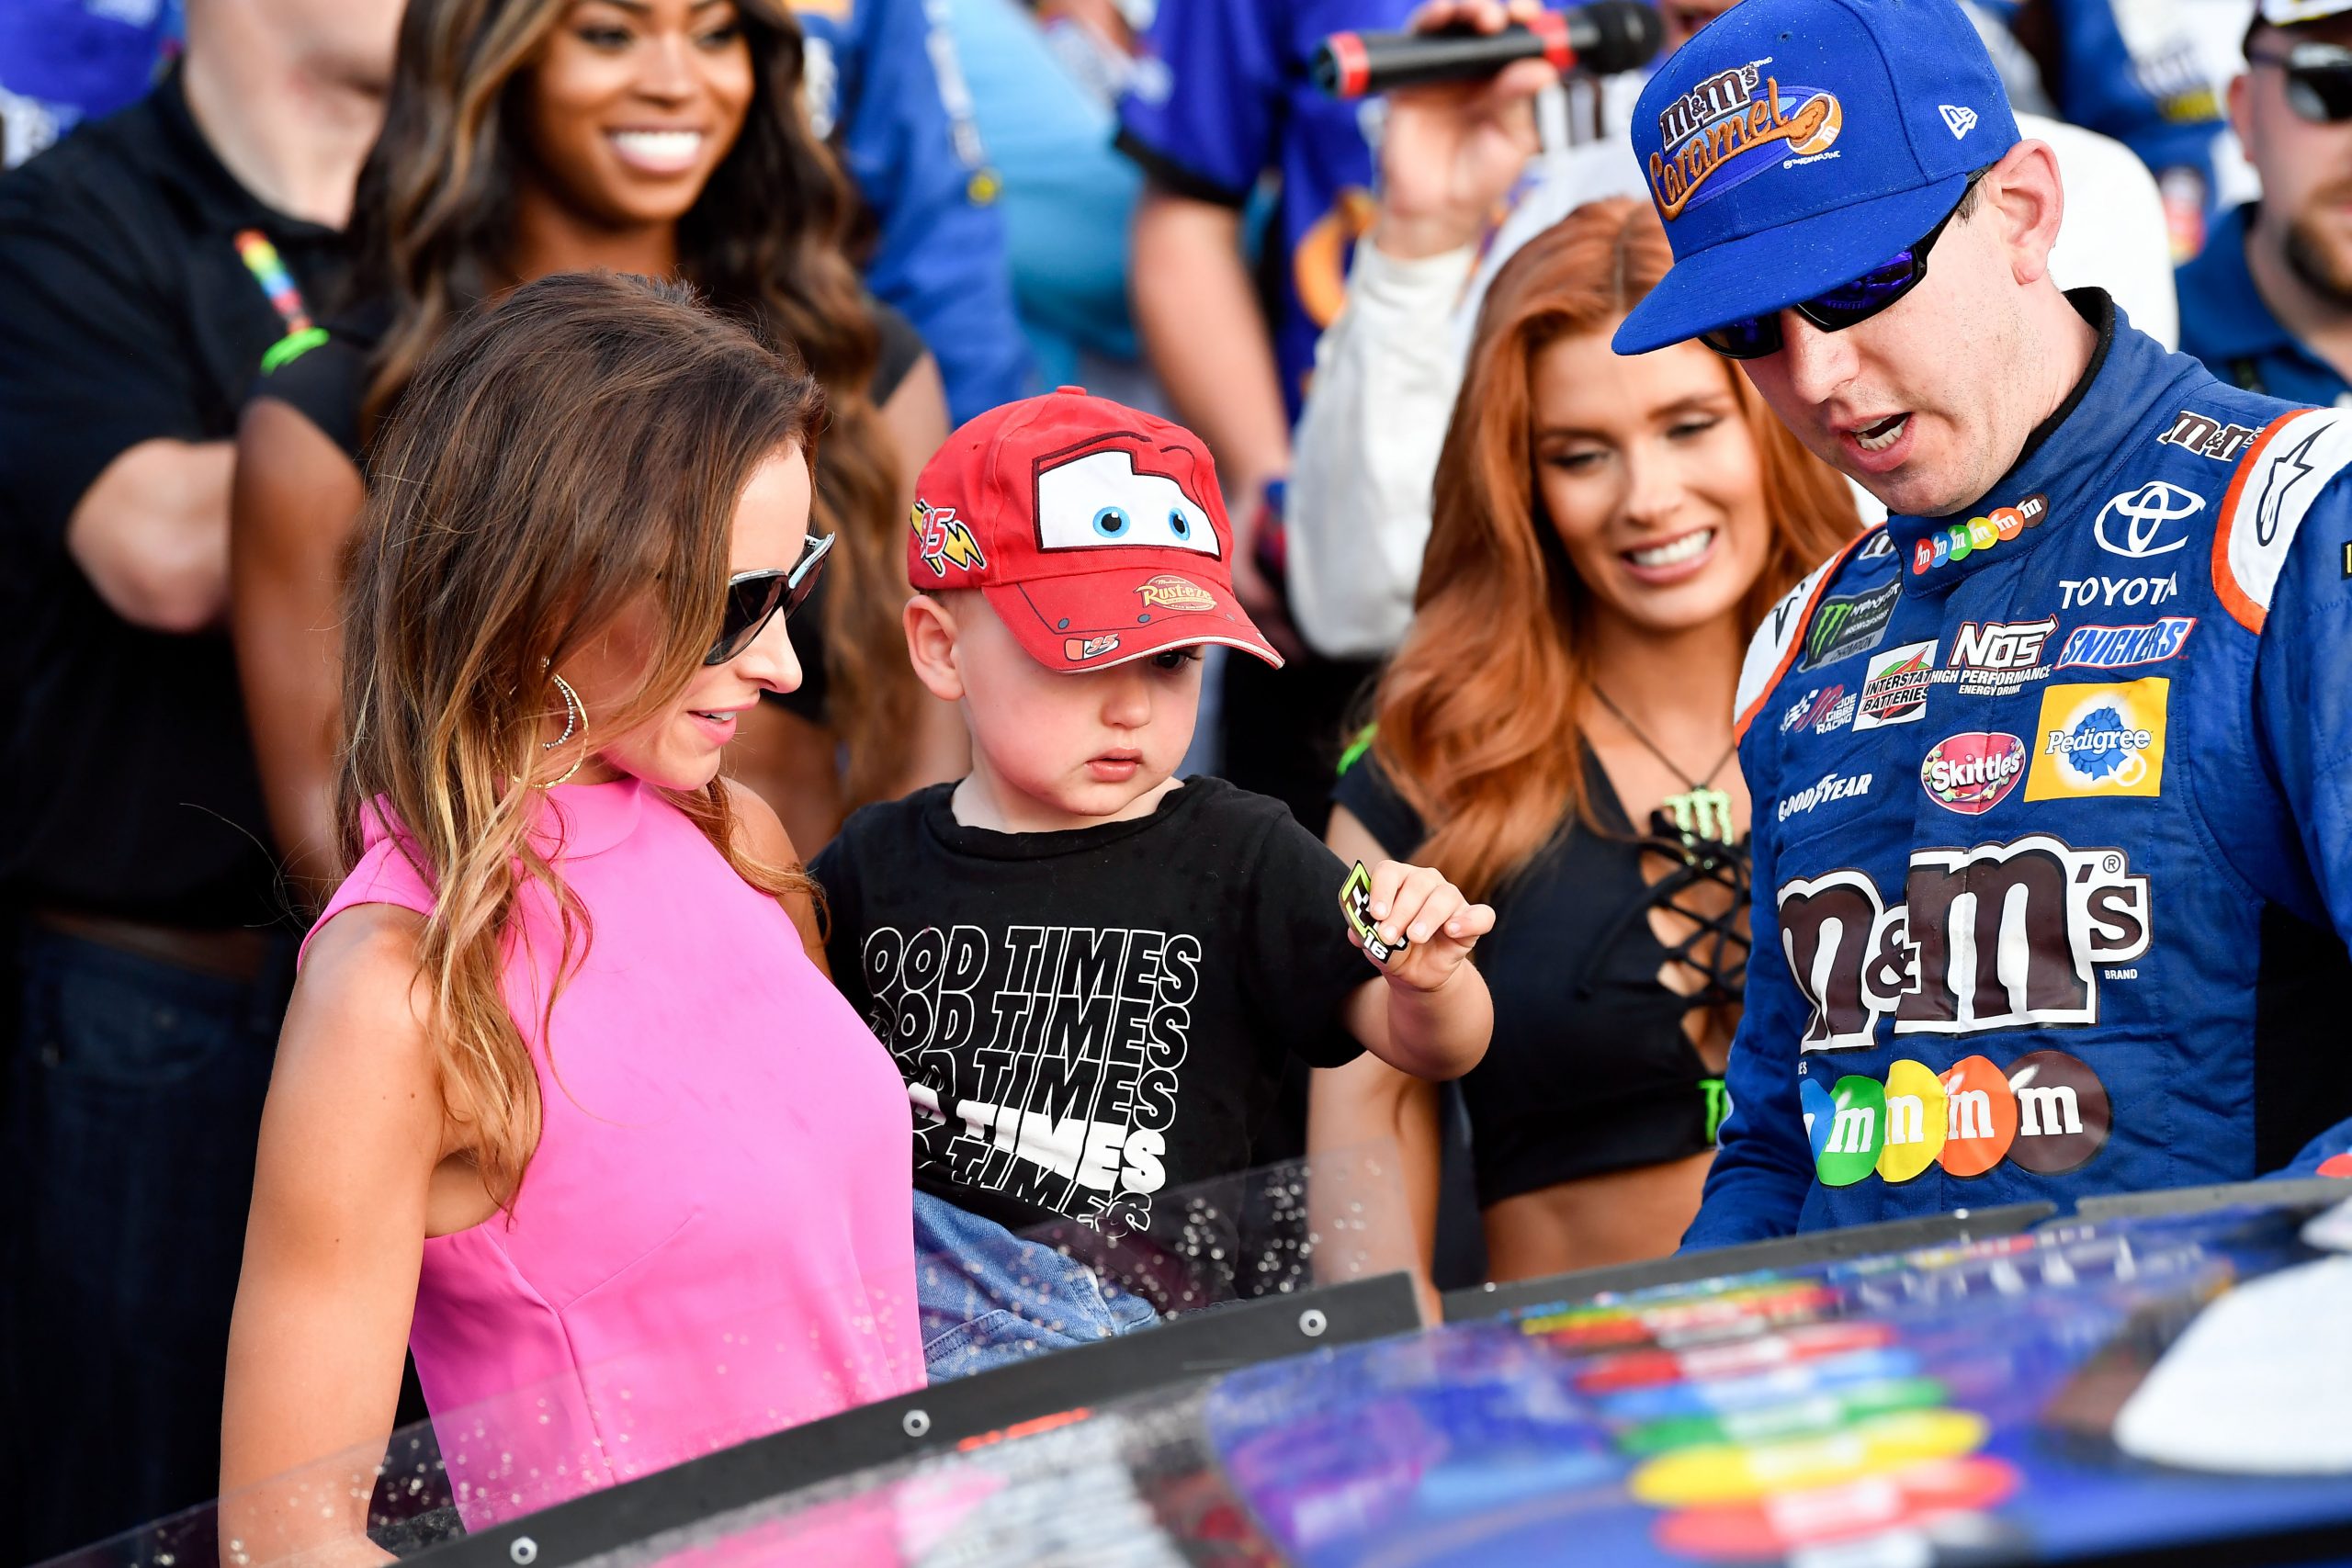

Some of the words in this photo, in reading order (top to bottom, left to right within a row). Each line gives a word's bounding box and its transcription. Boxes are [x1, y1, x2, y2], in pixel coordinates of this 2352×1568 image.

[1649, 76, 1790, 221] Caramel
[921, 507, 956, 559] 95
[2058, 570, 2178, 610] TOYOTA
[1086, 633, 1119, 654] 95
[1947, 614, 2059, 670] NOS
[2061, 621, 2189, 666] SNICKERS
[1930, 669, 1961, 684] HIGH
[1960, 663, 2052, 686] PERFORMANCE
[1958, 684, 1998, 696] ENERGY
[1996, 683, 2023, 697] DRINK
[1826, 703, 1856, 723] GIBBS
[1836, 692, 1857, 710] JOE
[1862, 687, 1928, 713] BATTERIES
[1816, 713, 1854, 735] RACING
[2045, 728, 2152, 755] Pedigree
[1930, 750, 2021, 793] Skittles
[1778, 773, 1873, 823] GOODYEAR
[1004, 925, 1203, 1007] TIMES
[1363, 931, 1389, 961] 16
[2104, 969, 2139, 981] BRAND
[991, 991, 1191, 1070] TIMES
[972, 1048, 1180, 1133] TIMES
[956, 1099, 1167, 1194] TIMES
